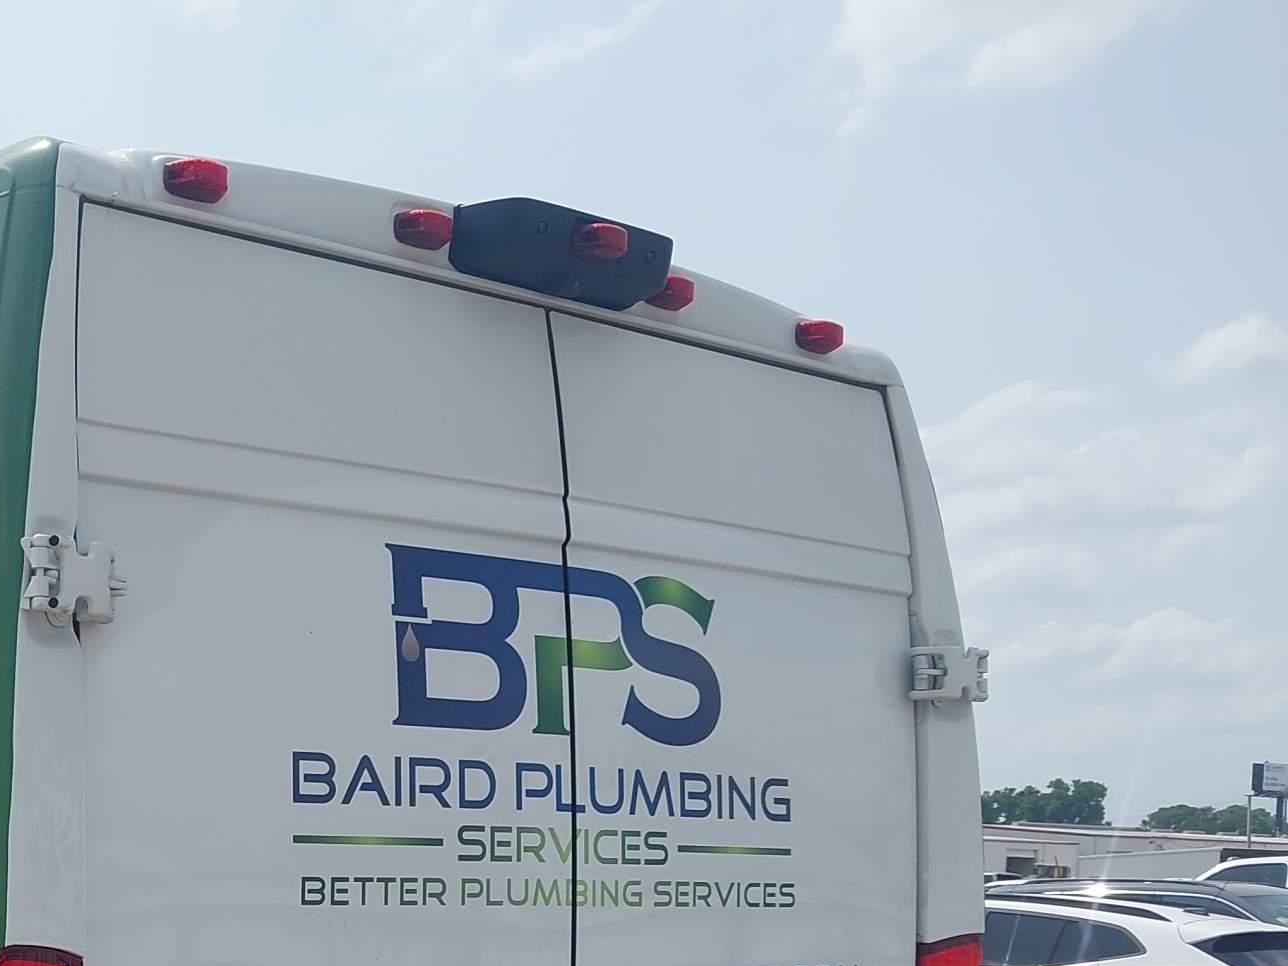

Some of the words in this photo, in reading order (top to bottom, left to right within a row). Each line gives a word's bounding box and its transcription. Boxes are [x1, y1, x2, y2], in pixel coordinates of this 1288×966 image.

[385, 542, 722, 747] BPS
[291, 751, 498, 811] BAIRD
[515, 761, 792, 823] PLUMBING
[456, 824, 670, 867] SERVICES
[299, 875, 448, 908] BETTER
[460, 876, 644, 909] PLUMBING
[653, 880, 796, 910] SERVICES
